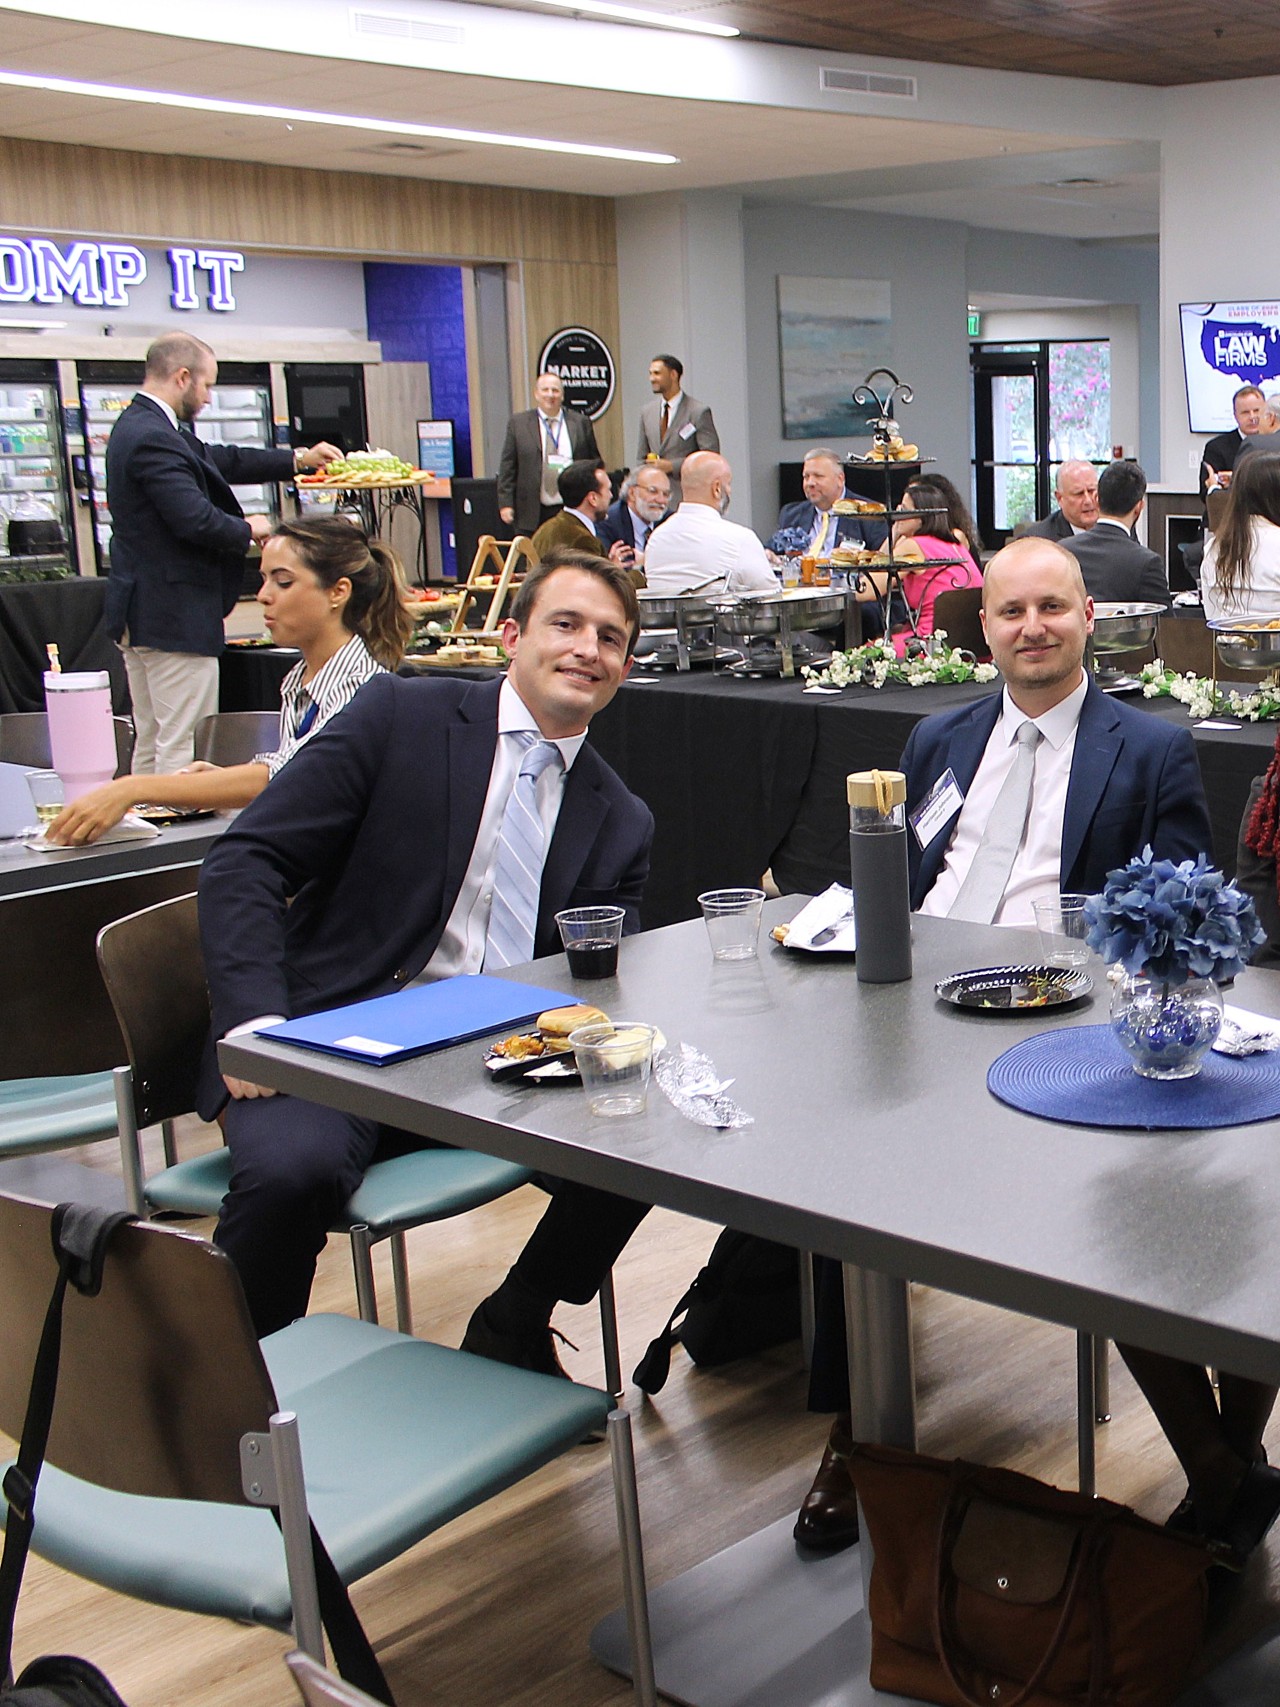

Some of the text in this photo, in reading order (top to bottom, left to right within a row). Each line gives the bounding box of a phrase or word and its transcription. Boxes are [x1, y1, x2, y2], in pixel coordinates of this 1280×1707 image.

[168, 248, 244, 311] IT
[1214, 335, 1266, 354] LAW
[1215, 351, 1268, 367] FIRMS
[547, 364, 608, 378] MARKET
